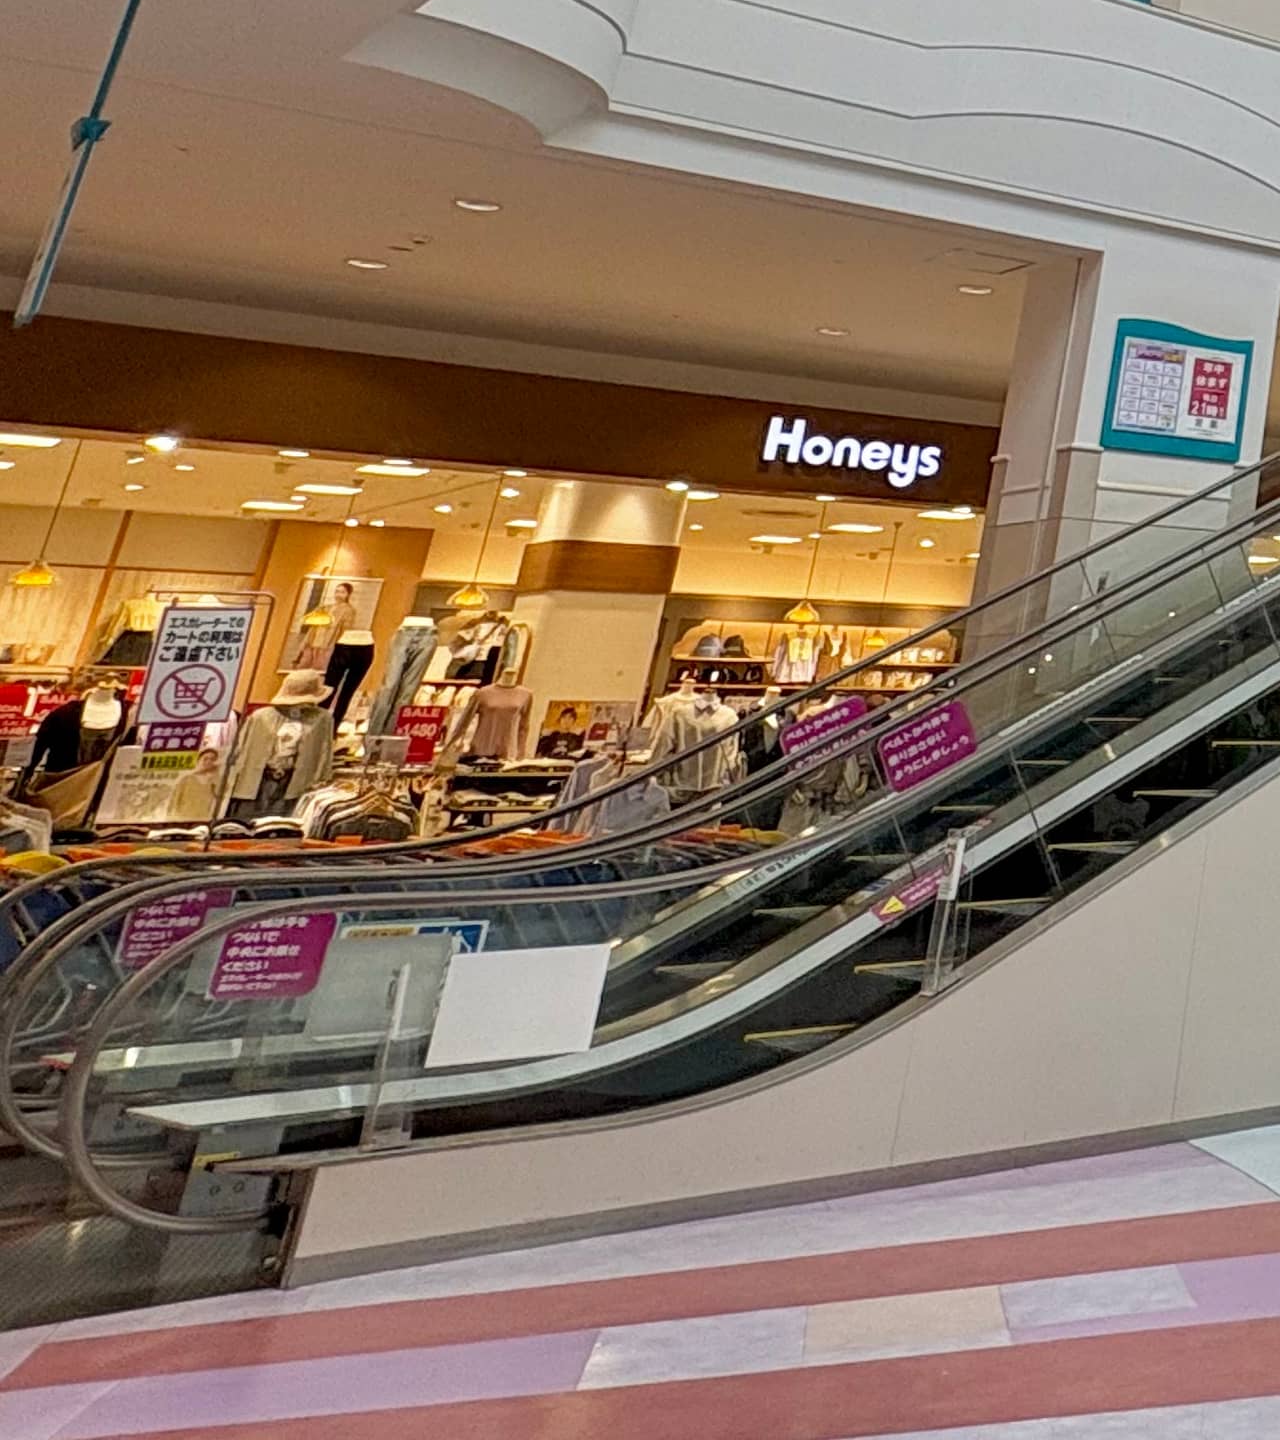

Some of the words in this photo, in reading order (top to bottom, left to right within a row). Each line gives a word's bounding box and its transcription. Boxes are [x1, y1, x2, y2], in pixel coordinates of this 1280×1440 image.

[762, 416, 942, 488] Honeys
[168, 617, 246, 629] エスカレーターでの
[164, 631, 244, 644] カートの利用は
[158, 646, 240, 663] ご遠慮下さい
[402, 707, 441, 718] SALE
